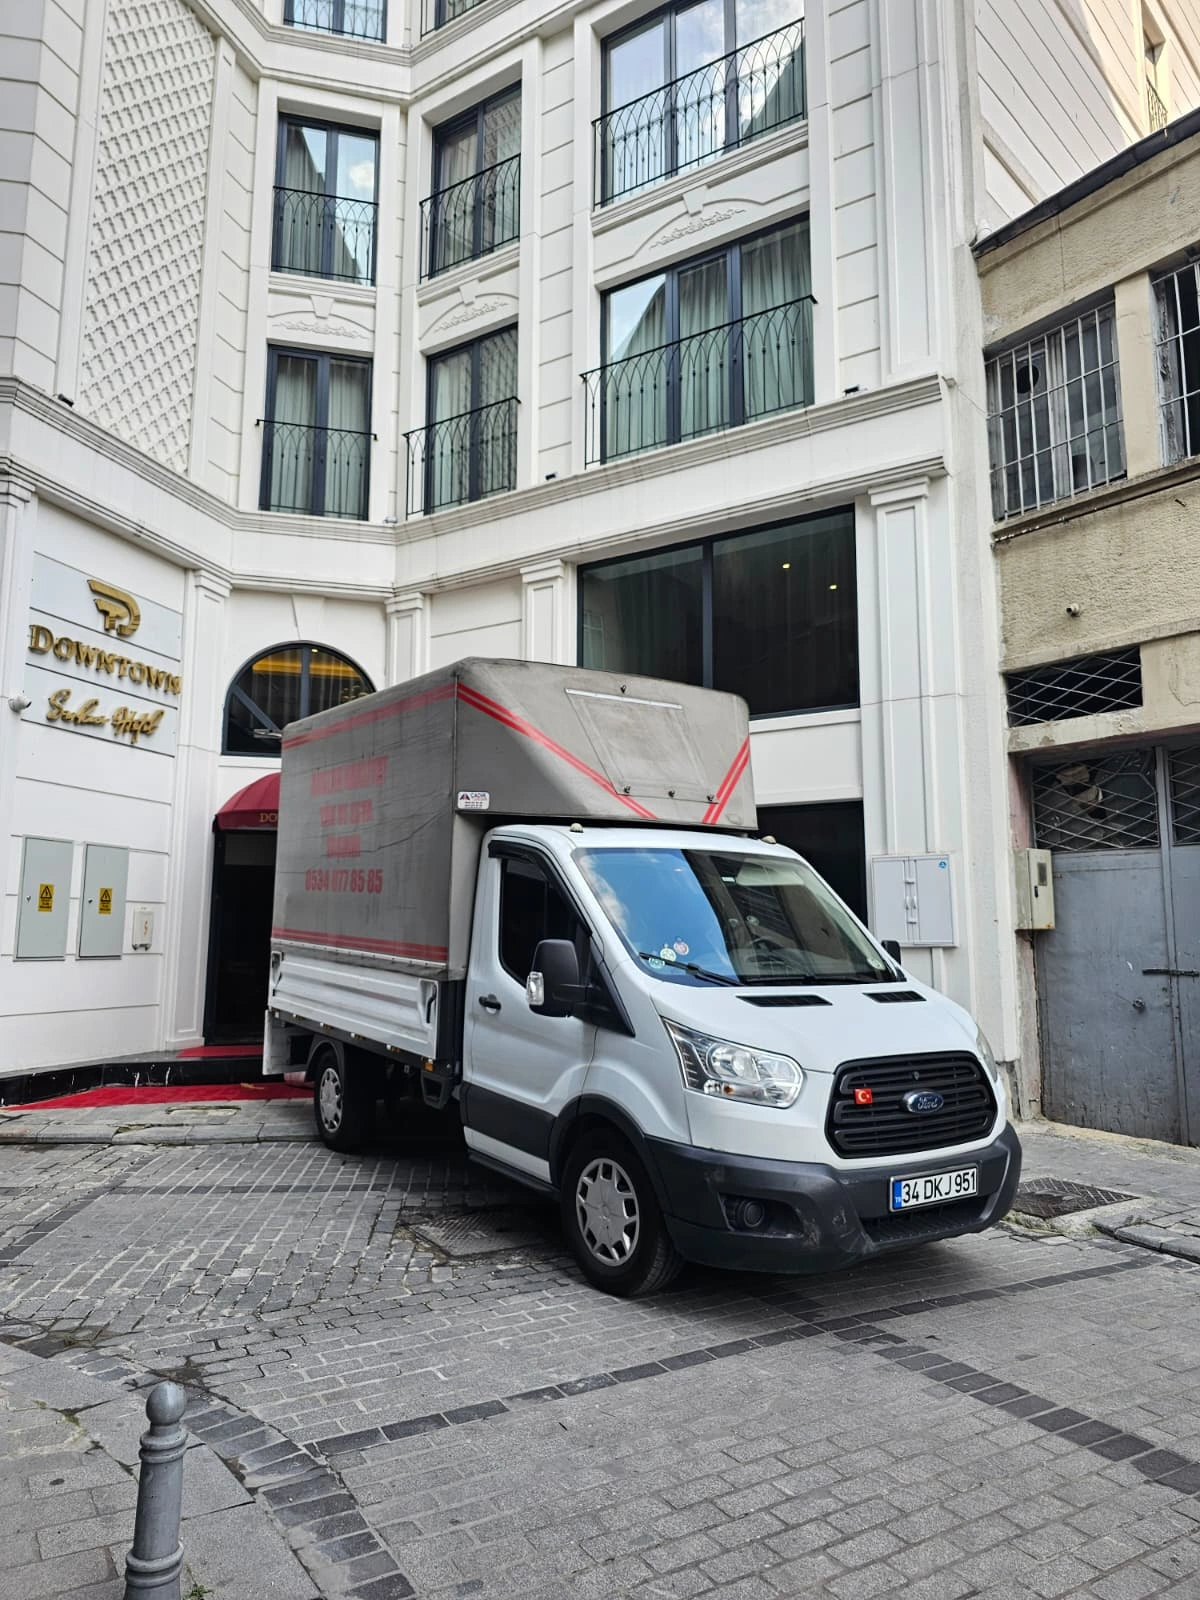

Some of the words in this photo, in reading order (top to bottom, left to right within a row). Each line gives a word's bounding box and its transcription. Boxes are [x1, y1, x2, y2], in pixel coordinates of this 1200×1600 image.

[28, 624, 182, 695] DOWNTOWN
[367, 869, 384, 894] 85
[917, 1096, 938, 1110] Ford
[902, 1181, 919, 1203] 34
[923, 1175, 952, 1200] DKJ
[954, 1170, 976, 1194] 951
